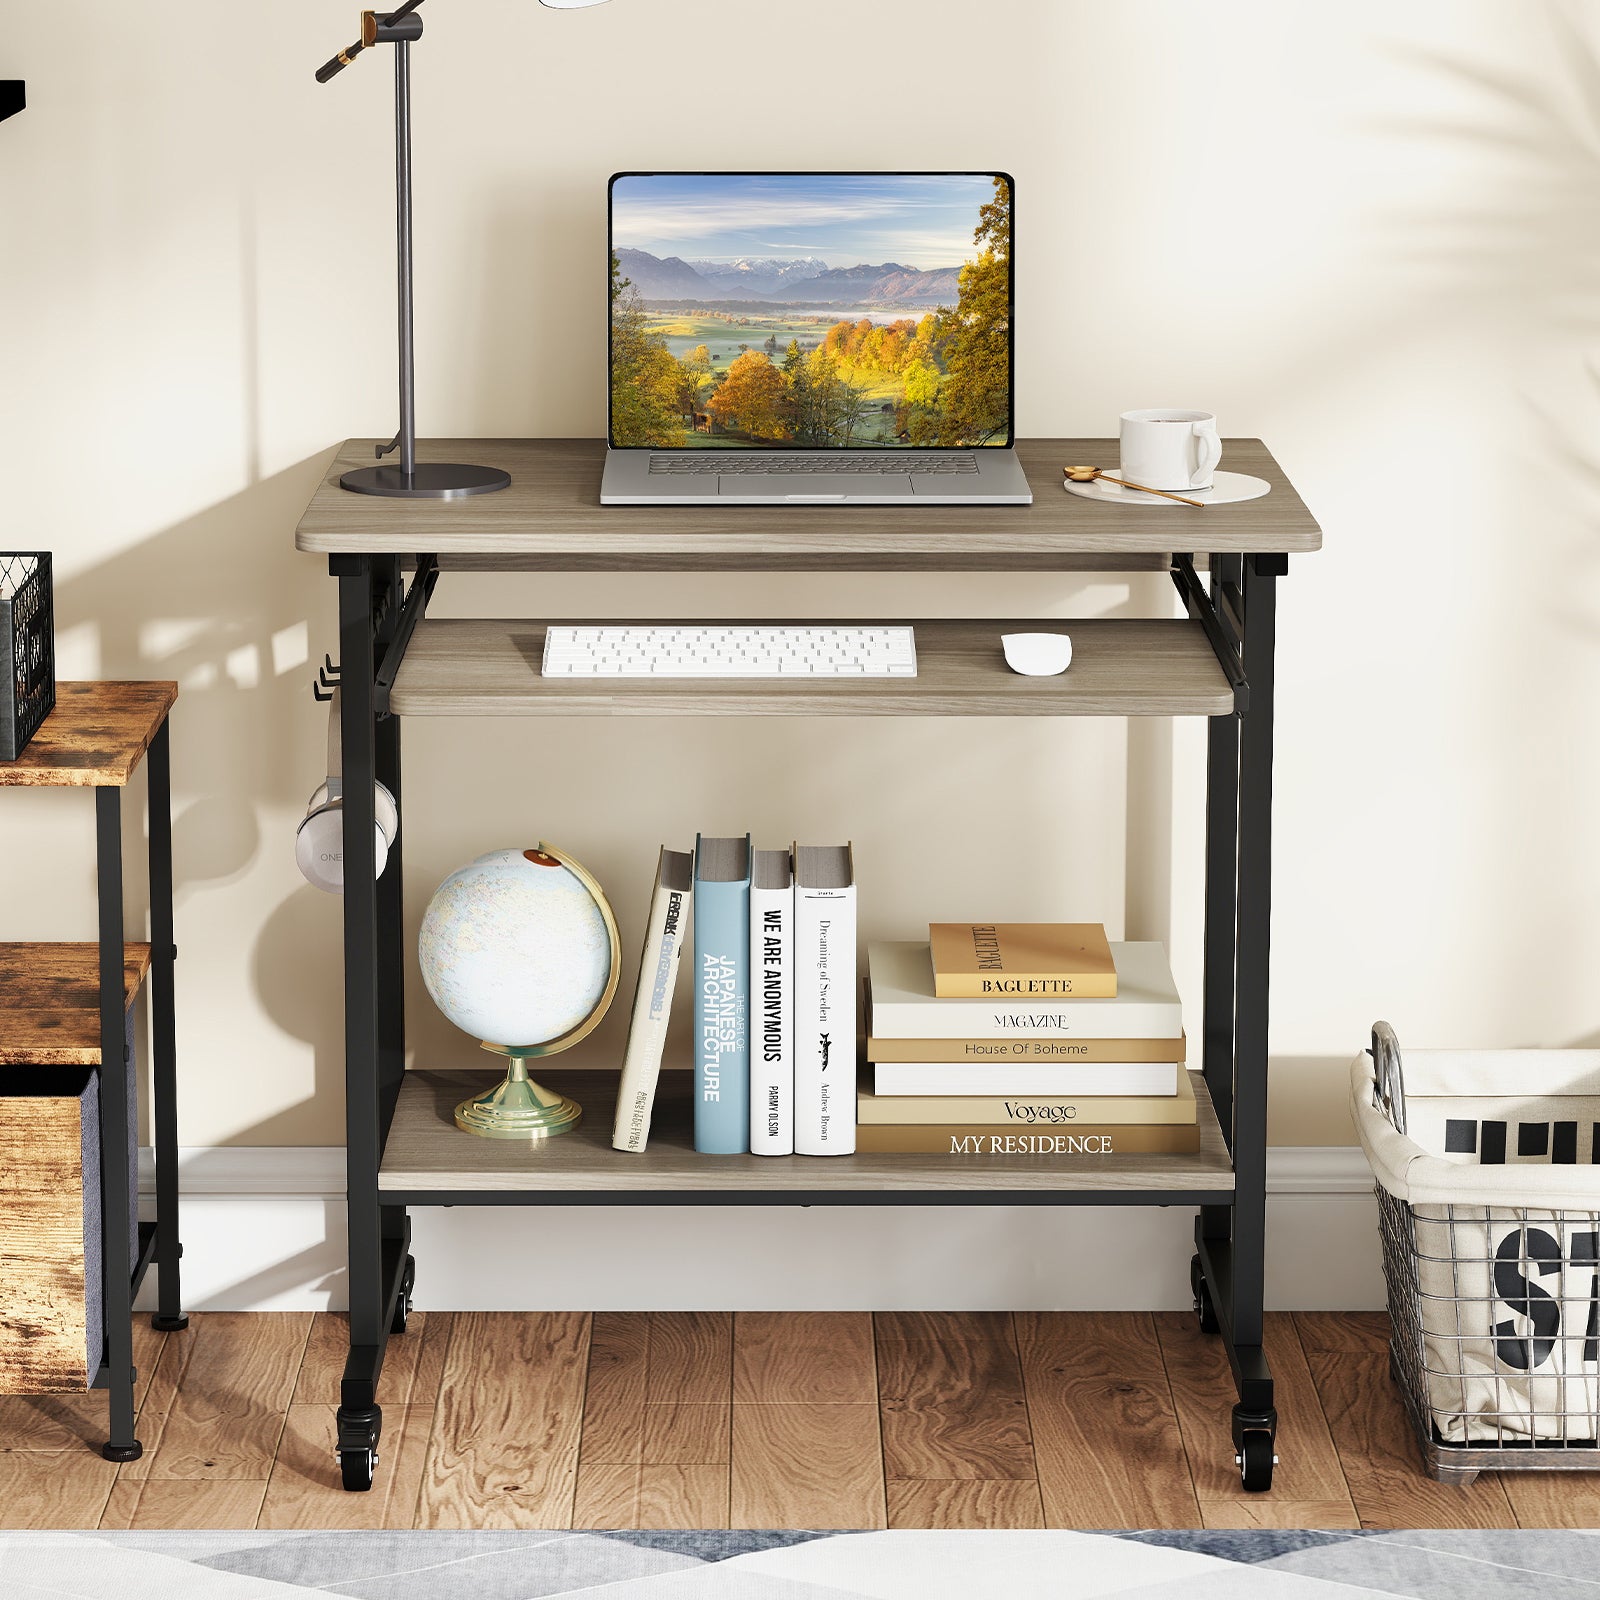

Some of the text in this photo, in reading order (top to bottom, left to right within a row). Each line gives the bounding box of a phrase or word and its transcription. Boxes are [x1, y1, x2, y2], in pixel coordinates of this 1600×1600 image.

[817, 920, 831, 1022] Dreaming of Sweden
[972, 926, 1003, 970] BAGUETTE
[719, 955, 736, 1053] JAPANESE
[763, 909, 782, 1062] WE ARE ANONYMOUS
[982, 980, 1073, 993] BAGUETTE
[703, 953, 720, 1103] ARCHITECTURE
[736, 993, 745, 1052] THE ART OF
[994, 1015, 1069, 1029] MAGAZINE
[965, 1043, 1088, 1055] House Of Boheme
[768, 1085, 779, 1137] PARMY OLSON
[820, 1083, 831, 1141] Andrew Brown
[1004, 1101, 1077, 1123] Voyage
[950, 1136, 1113, 1154] MY RESIDENCE
